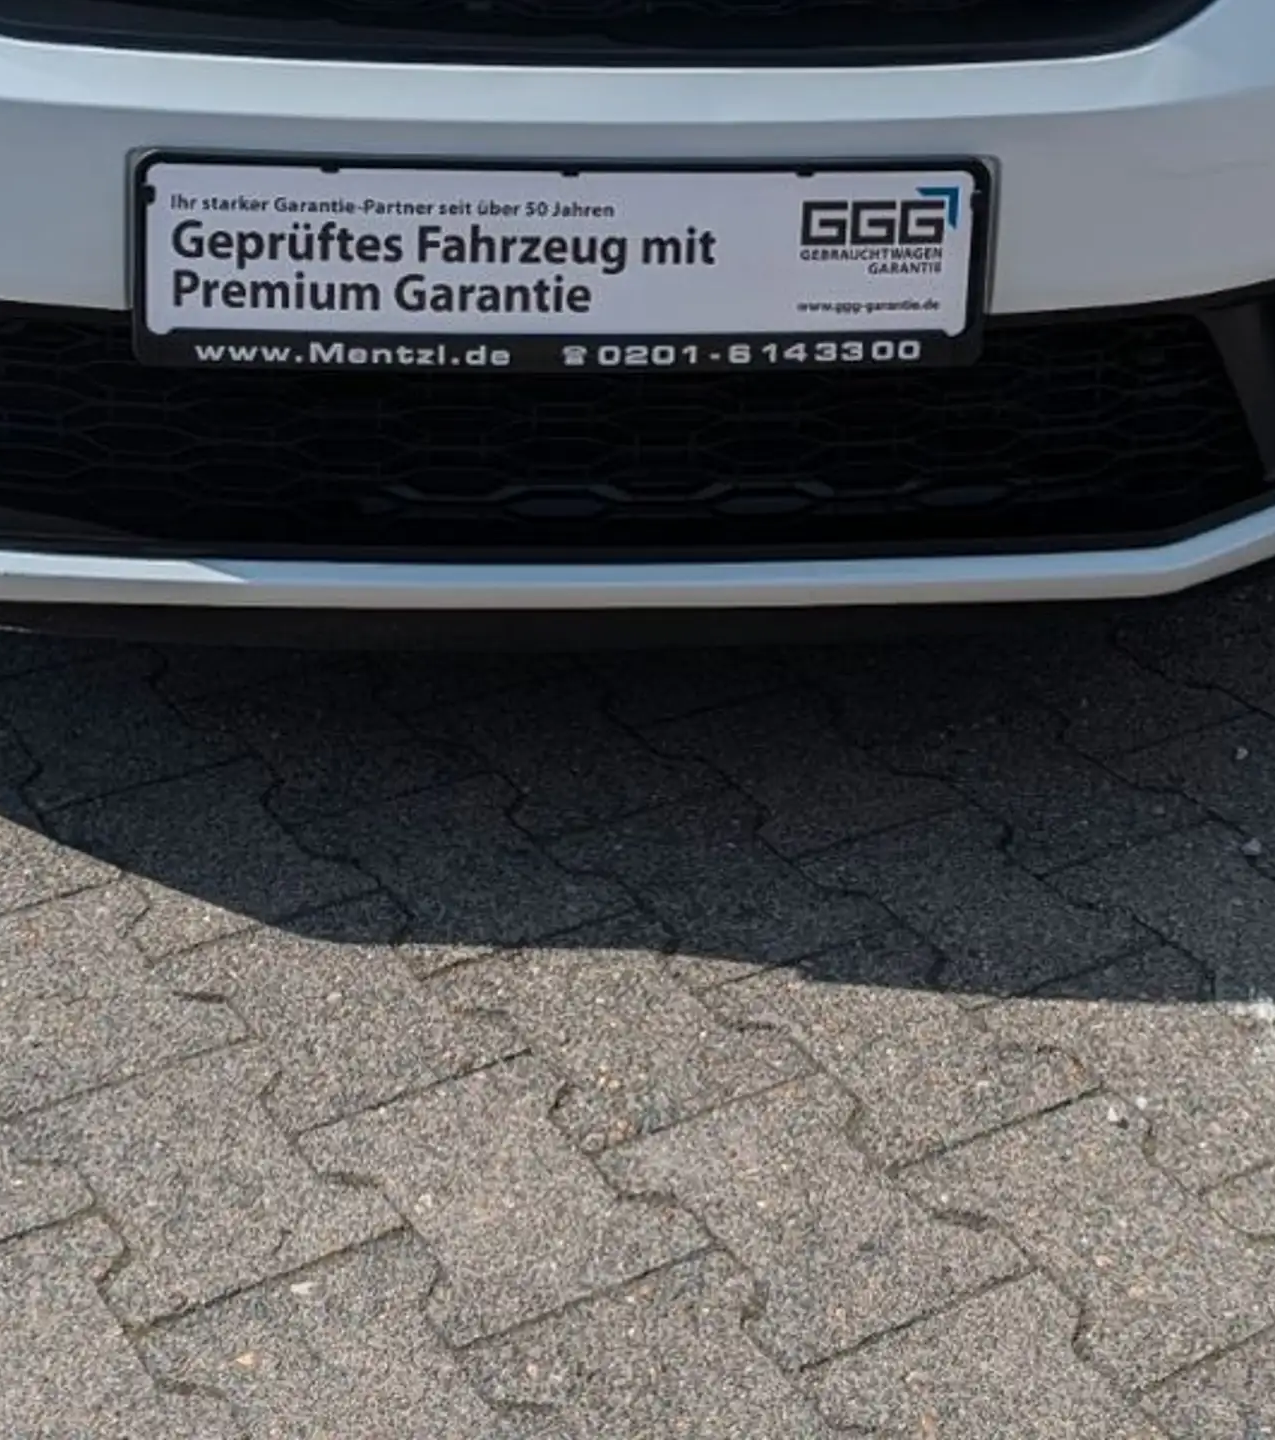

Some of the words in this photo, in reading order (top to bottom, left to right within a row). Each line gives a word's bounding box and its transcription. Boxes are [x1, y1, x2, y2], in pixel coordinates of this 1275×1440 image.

[171, 193, 198, 211] Ihr
[201, 194, 270, 212] starker
[273, 196, 433, 216] Garantie-Partner
[438, 199, 472, 216] seit
[477, 199, 521, 217] über
[525, 201, 548, 218] 50
[551, 201, 615, 218] Jahren
[800, 200, 945, 246] GGG
[171, 218, 404, 270] Geprüftes
[418, 223, 628, 276] Fahrzeug
[642, 225, 717, 266] mit
[799, 246, 943, 262] GEBRAUCHTWAGEN
[867, 261, 942, 275] GARANTIE
[173, 268, 381, 312] Premium
[393, 272, 593, 313] Garantie
[796, 297, 941, 315] www.ggg-garantie.de
[194, 340, 512, 366] www.Mentzl.de
[597, 339, 922, 366] 0201-6143300
